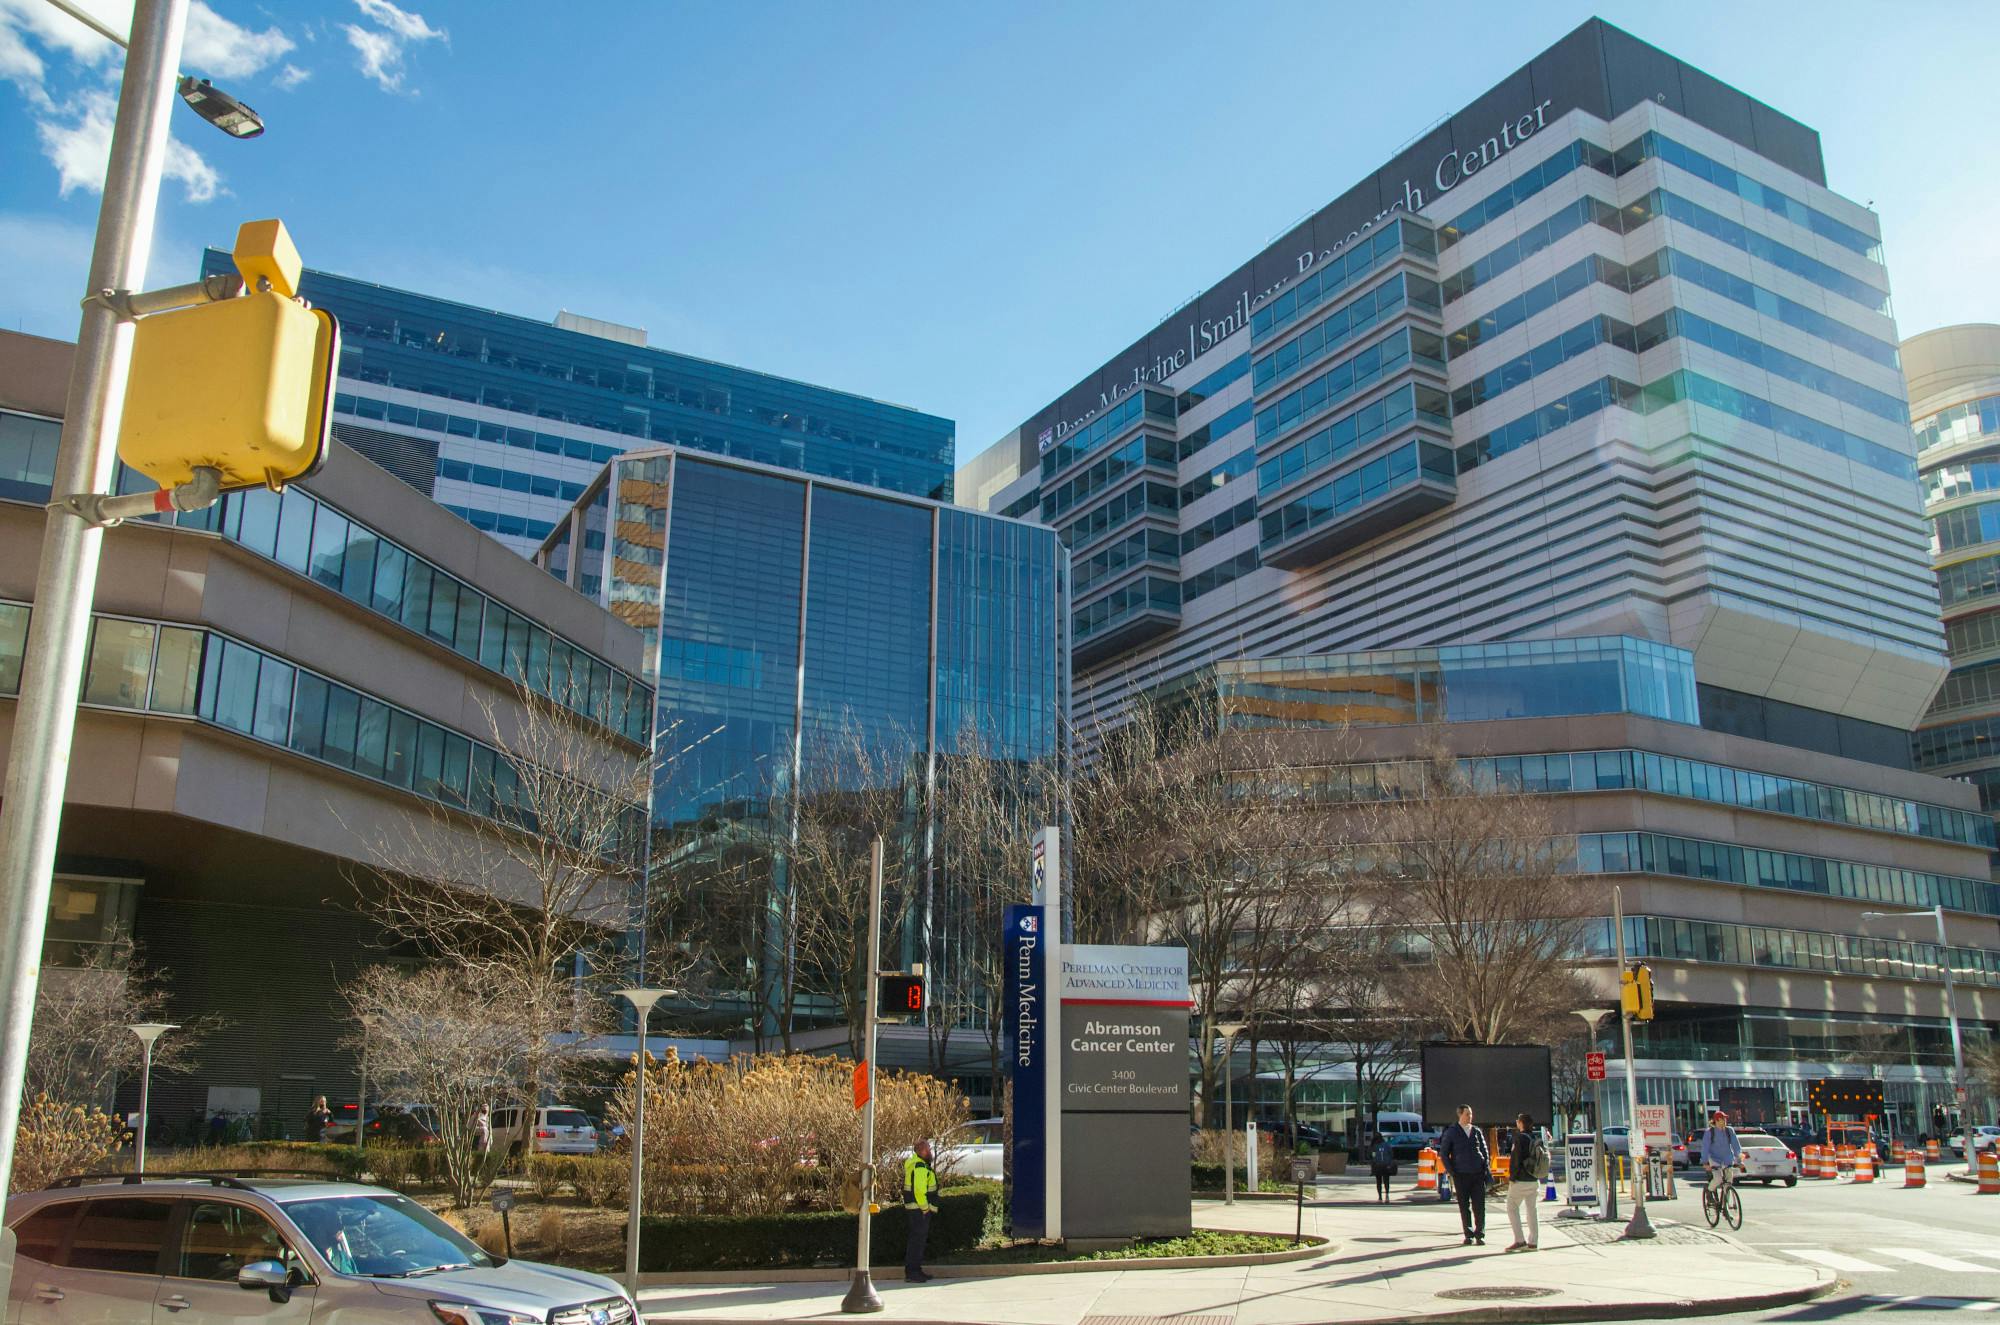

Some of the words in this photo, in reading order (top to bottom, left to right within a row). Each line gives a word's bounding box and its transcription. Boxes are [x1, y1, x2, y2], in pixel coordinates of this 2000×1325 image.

[1200, 276, 1290, 352] Smilo
[1435, 99, 1551, 191] Center
[1019, 935, 1036, 979] Penn
[1062, 961, 1119, 975] PERELMAN
[1121, 963, 1162, 976] CENTER
[1163, 966, 1183, 976] FOR
[1066, 976, 1125, 989] ADVANCED
[1127, 978, 1180, 990] MEDICINE
[1019, 983, 1037, 1067] Medicine
[1084, 1020, 1161, 1036] Abramson
[1070, 1038, 1122, 1052] Cancer
[1126, 1039, 1175, 1053] Center
[1111, 1070, 1136, 1080] 3400
[1068, 1083, 1092, 1093] Civic
[1094, 1083, 1127, 1094] Center
[1129, 1083, 1178, 1095] Boulevard
[1640, 1119, 1661, 1128] HERE
[1569, 1146, 1593, 1157] VALET
[1570, 1159, 1593, 1169] DROP
[1574, 1171, 1590, 1181] OFF
